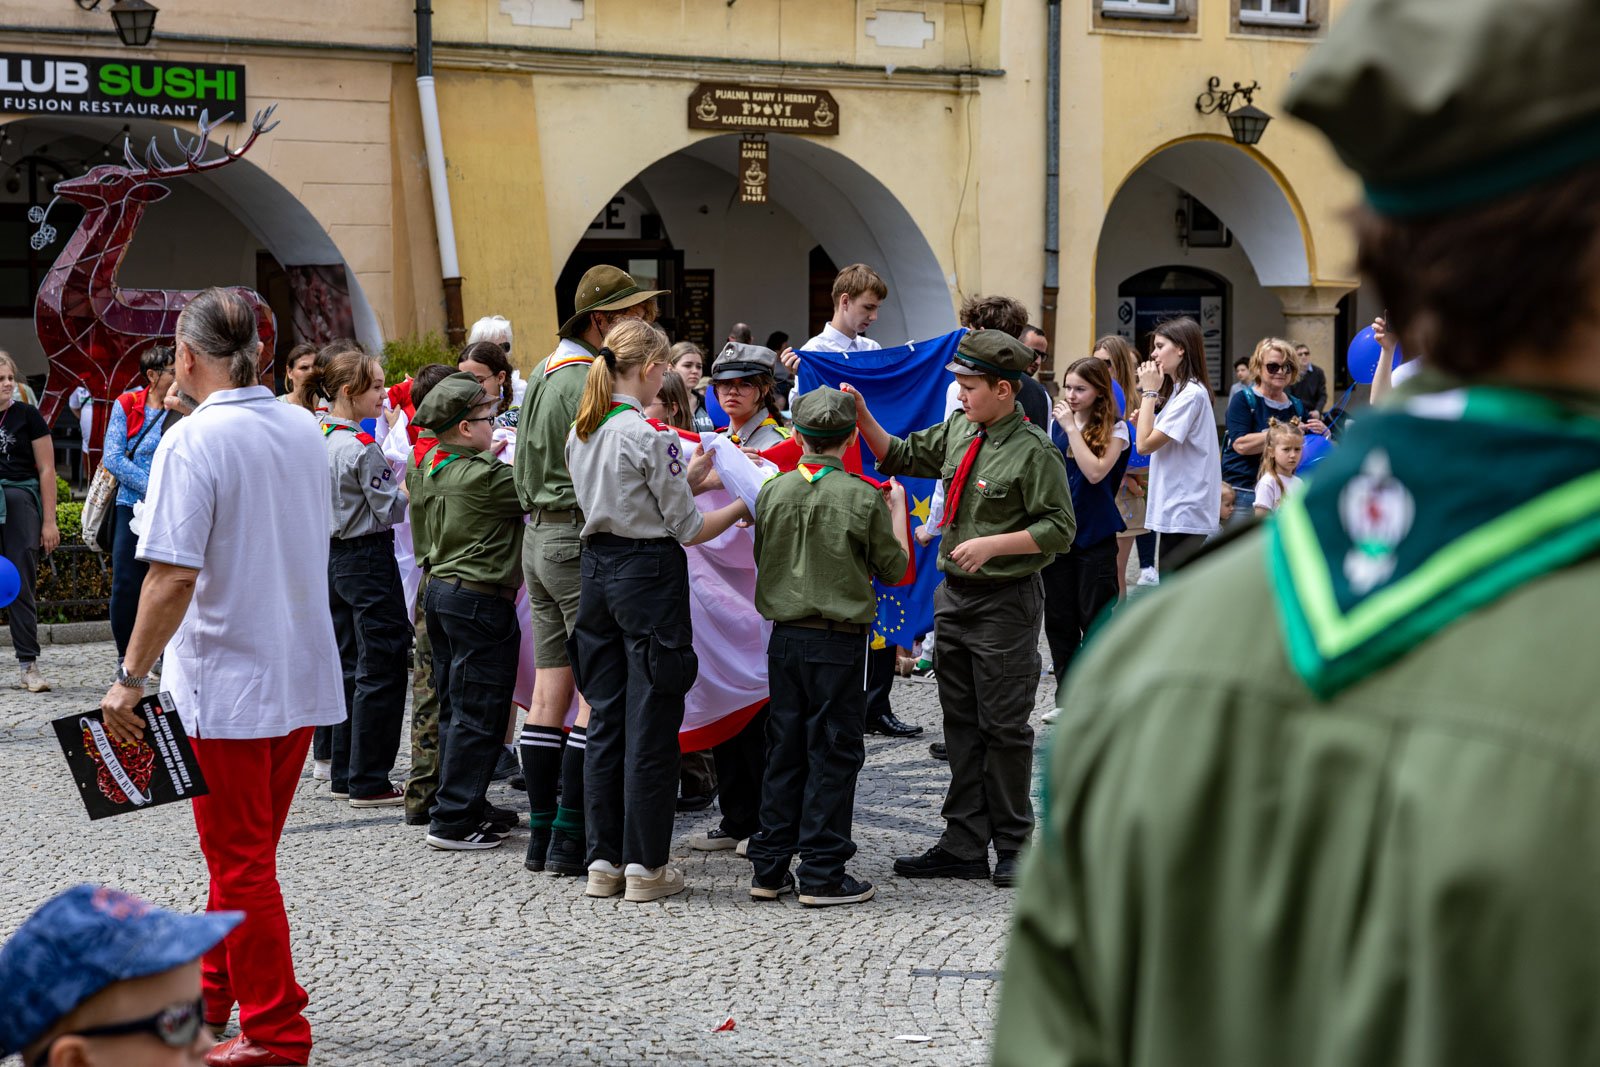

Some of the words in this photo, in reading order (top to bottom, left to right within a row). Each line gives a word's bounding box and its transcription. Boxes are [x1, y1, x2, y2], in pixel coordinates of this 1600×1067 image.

[0, 57, 89, 94] LUB
[98, 63, 236, 100] SUSHI
[4, 97, 72, 112] FUSION
[79, 101, 199, 117] RESTAURANT
[715, 89, 750, 100] PIJALNIA
[752, 91, 775, 102] KAWY
[784, 93, 817, 104] HERBATY
[721, 115, 768, 126] KAFFEEBAR
[769, 118, 778, 126] &
[778, 118, 809, 128] TEEBAR
[742, 150, 767, 159] KAFFEE
[745, 186, 762, 195] TEE
[142, 702, 160, 732] ŚWIATA
[153, 731, 170, 758] KOŃCA
[168, 739, 183, 762] DZIEŃ
[164, 757, 175, 769] DO
[176, 761, 192, 785] JEDEN
[168, 768, 185, 795] GRAMY
